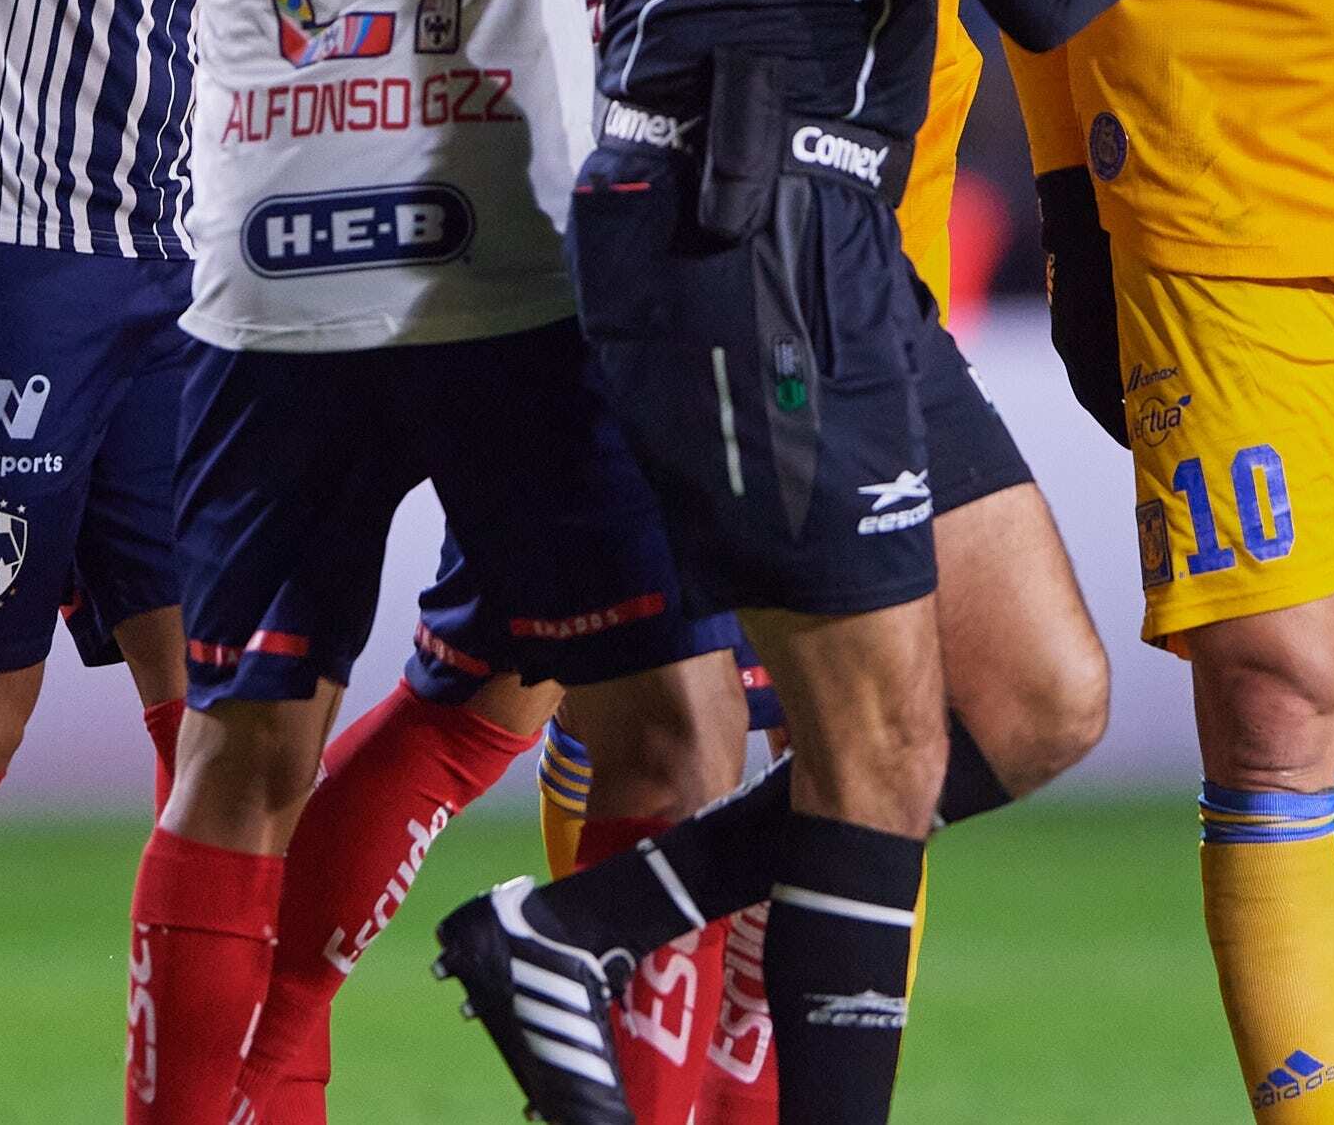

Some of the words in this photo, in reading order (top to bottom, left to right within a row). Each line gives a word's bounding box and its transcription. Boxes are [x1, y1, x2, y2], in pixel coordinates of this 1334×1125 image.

[221, 78, 411, 144] ALFONSO
[792, 126, 890, 183] Comex
[1172, 443, 1295, 577] 10
